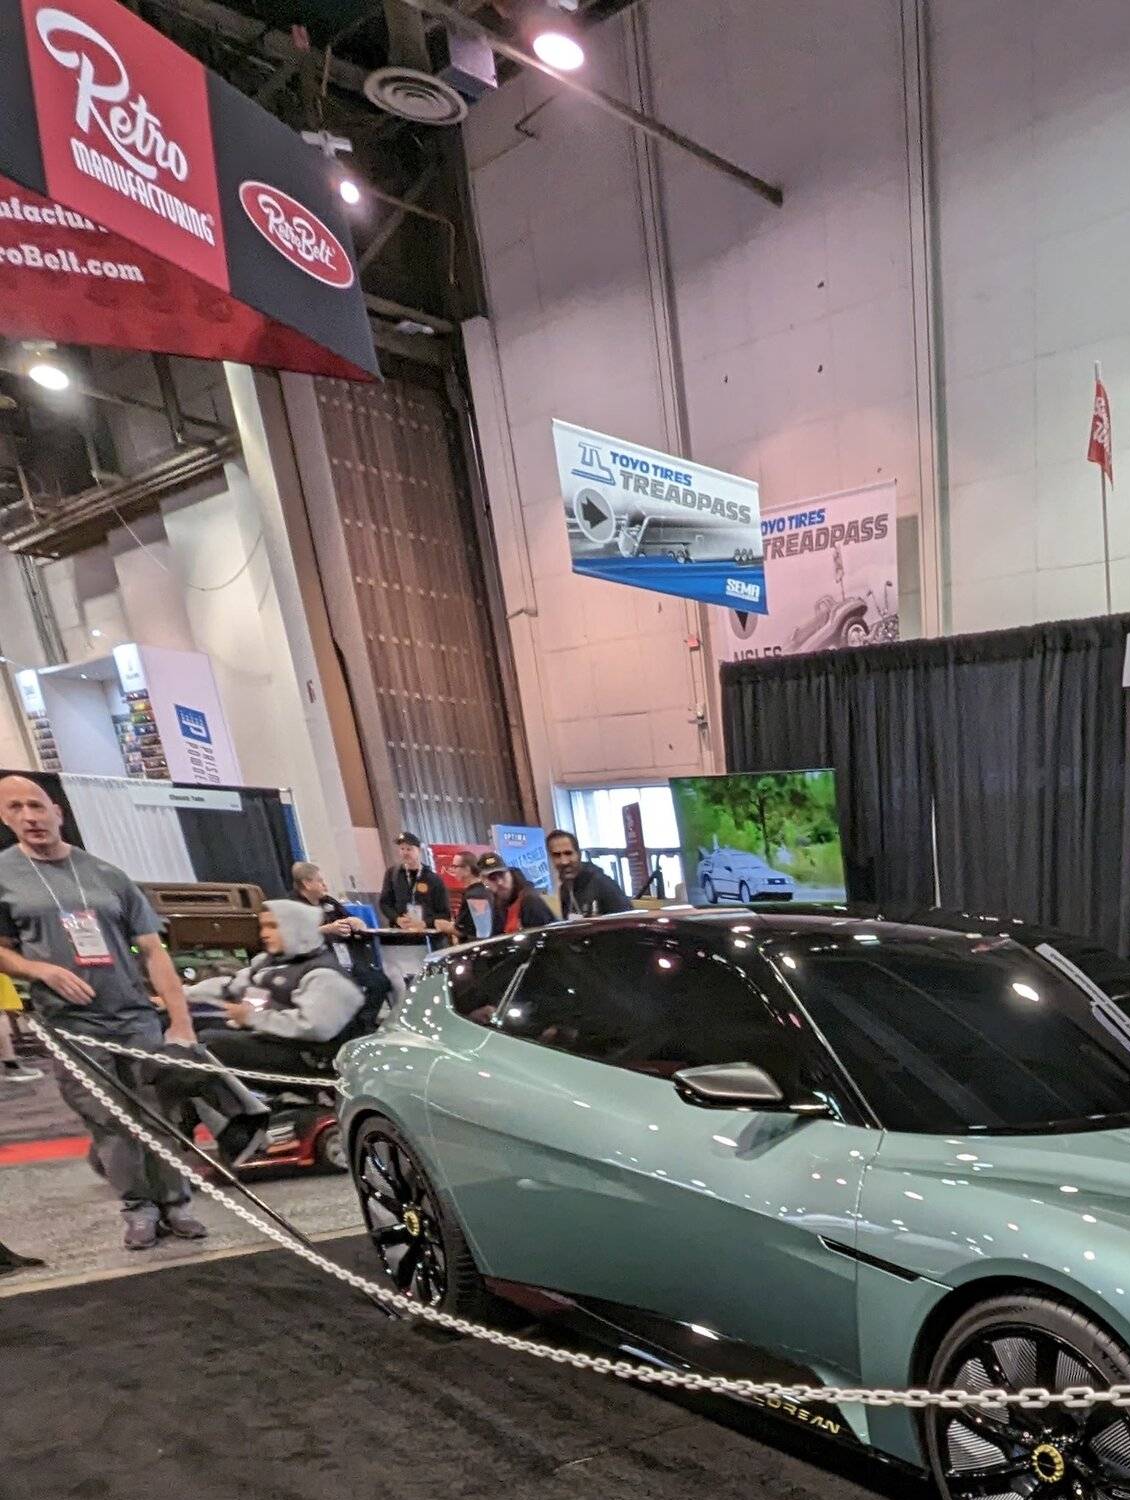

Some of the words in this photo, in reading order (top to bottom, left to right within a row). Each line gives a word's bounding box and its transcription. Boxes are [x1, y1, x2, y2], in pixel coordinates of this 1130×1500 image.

[36, 8, 188, 182] Retro
[70, 137, 216, 247] MANUFACTURING
[610, 450, 650, 473] TOYO
[652, 464, 693, 487] TIRES
[619, 471, 751, 525] TREADPASS
[761, 517, 786, 536] OYO
[787, 508, 825, 530] TIRES
[726, 578, 760, 599] SEMA
